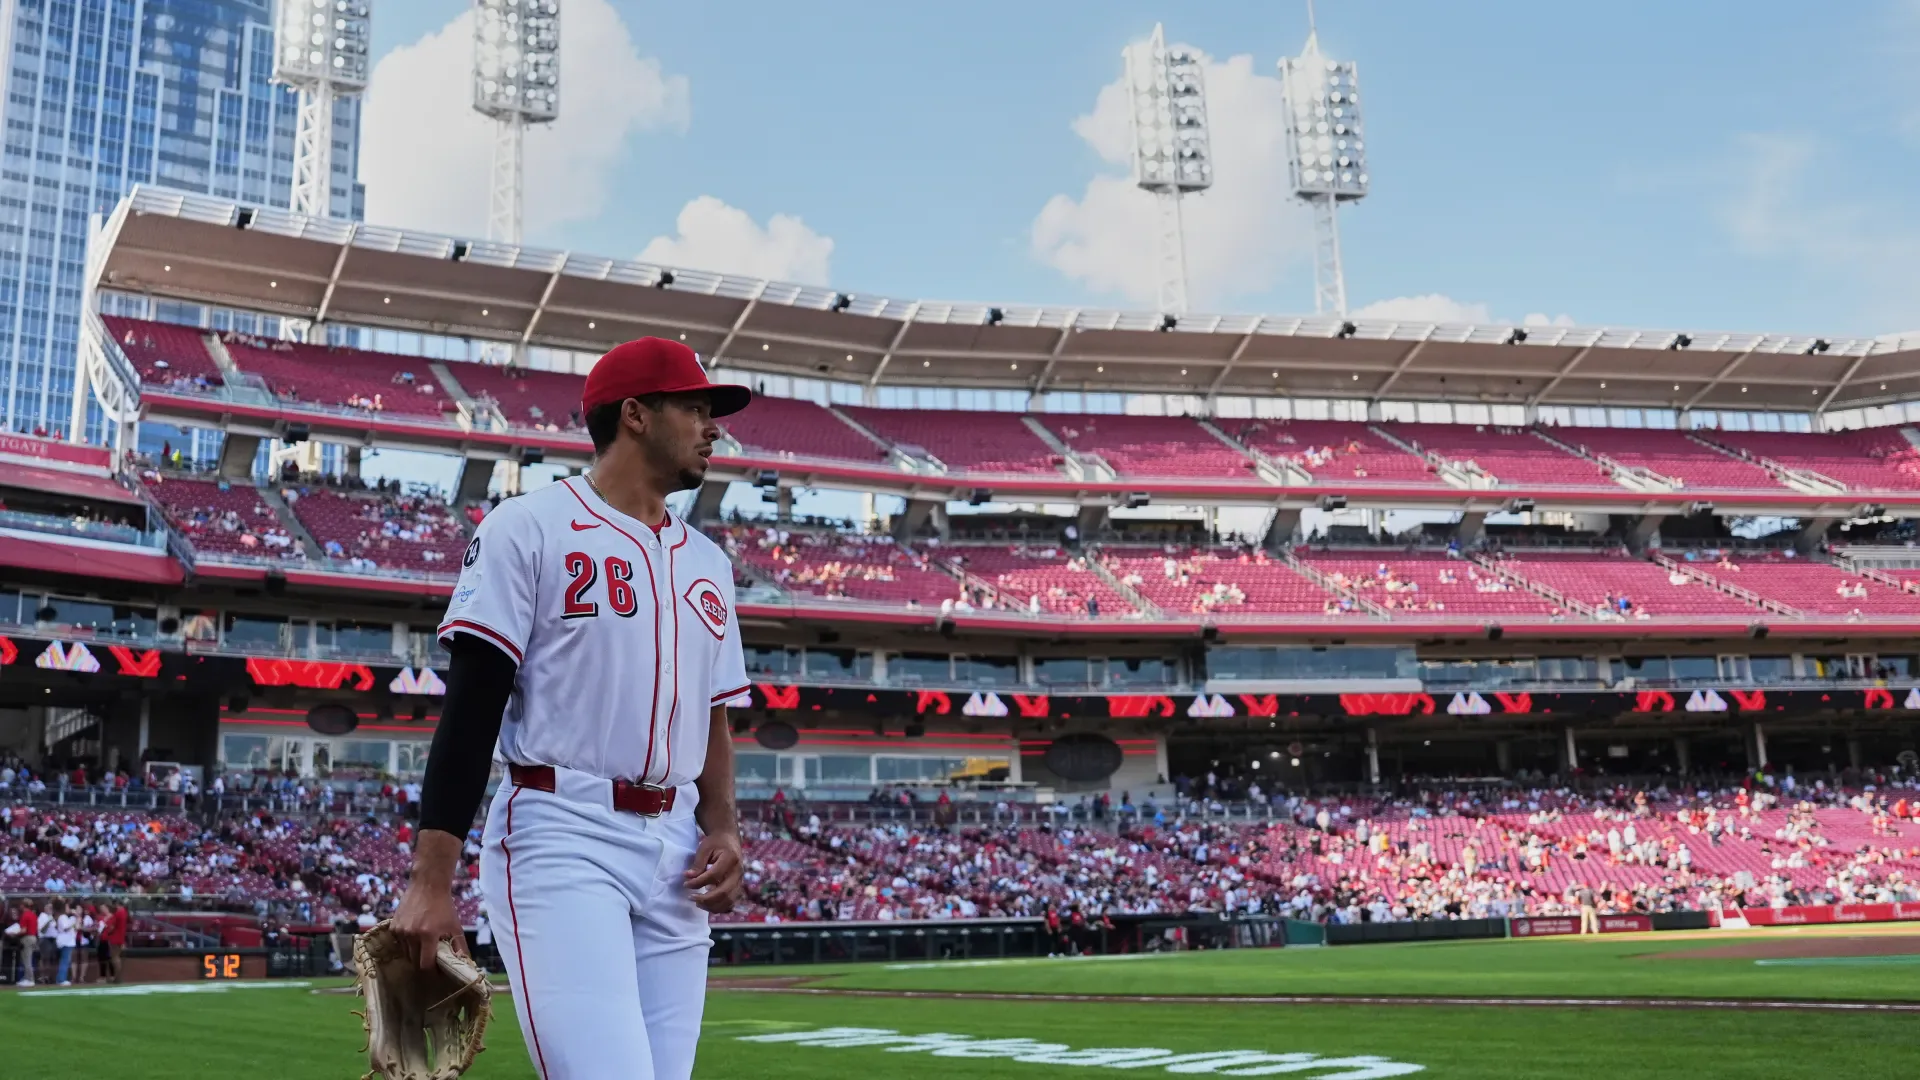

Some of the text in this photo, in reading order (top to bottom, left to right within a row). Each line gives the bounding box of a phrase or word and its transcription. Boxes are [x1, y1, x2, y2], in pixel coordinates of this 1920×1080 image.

[467, 540, 479, 563] 14
[560, 551, 638, 618] 26
[701, 597, 727, 624] REDS
